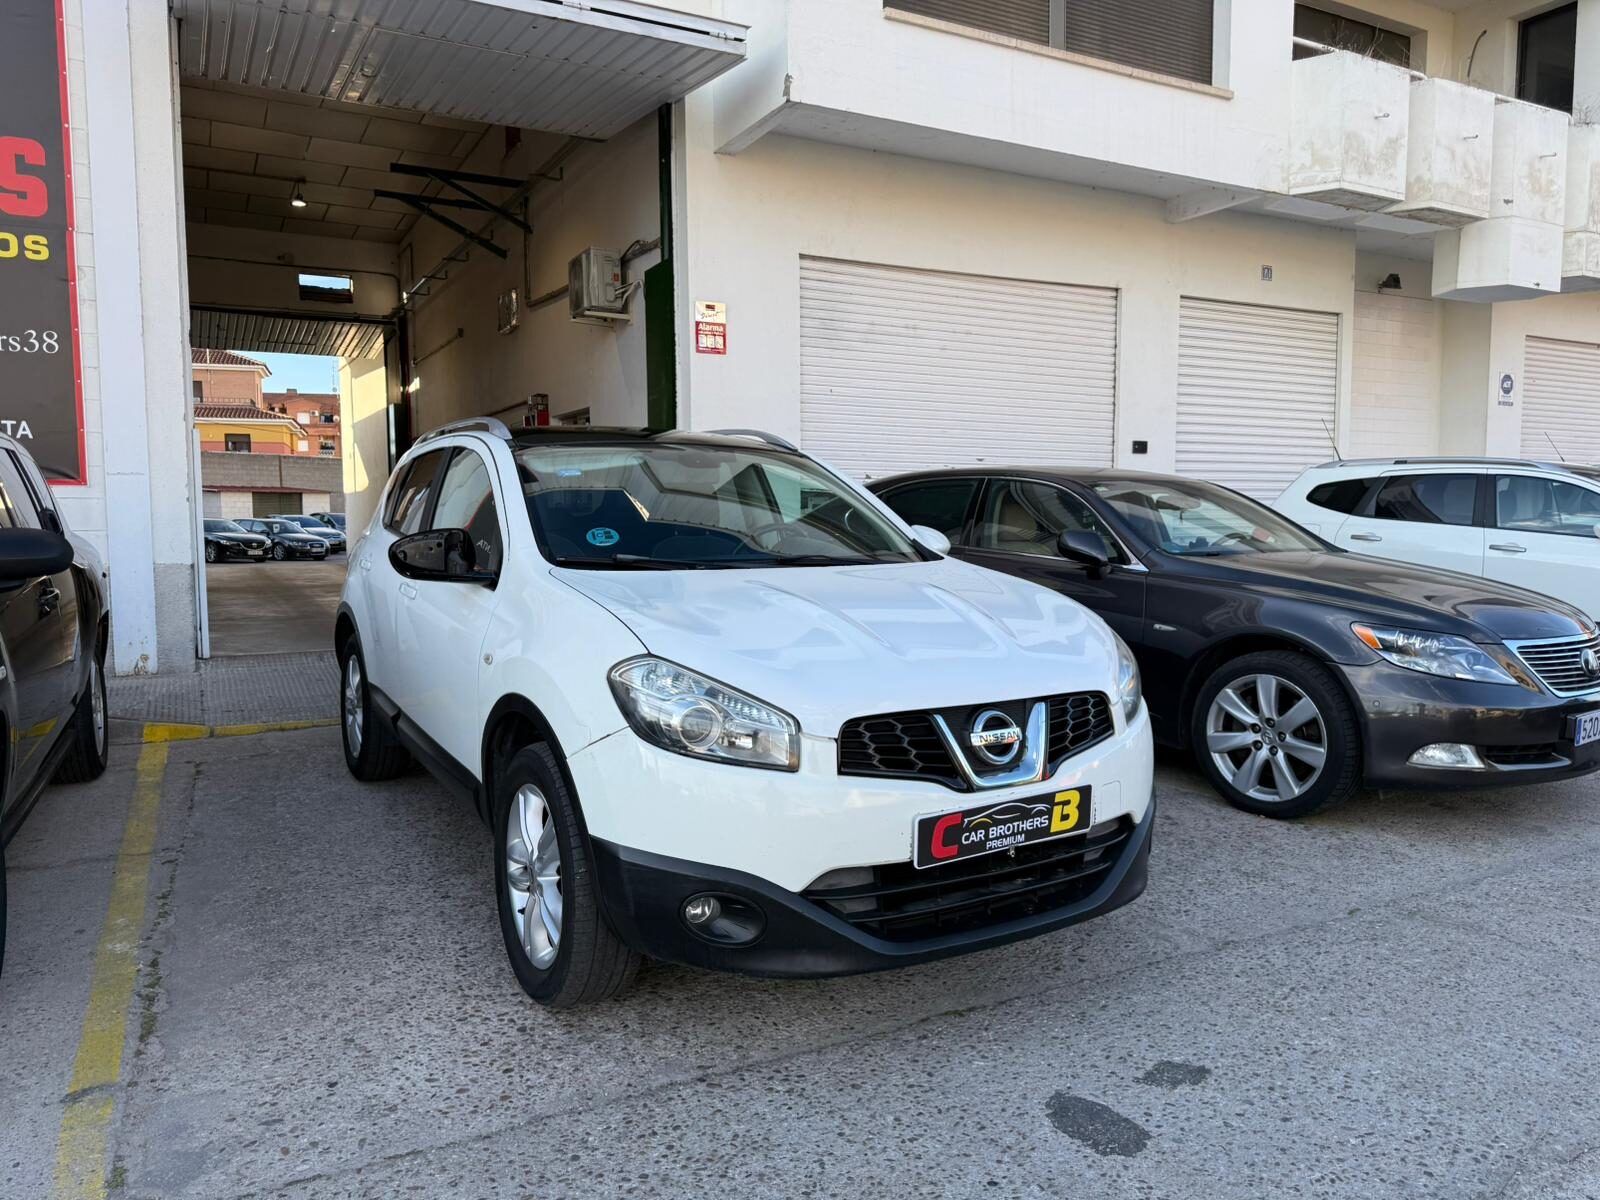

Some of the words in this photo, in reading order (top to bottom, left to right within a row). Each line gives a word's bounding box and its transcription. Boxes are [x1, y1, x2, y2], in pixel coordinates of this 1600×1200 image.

[698, 322, 724, 332] Alarma
[979, 730, 1020, 743] NISSAN
[961, 831, 985, 845] CAR
[988, 815, 1049, 839] BROTHERS
[986, 834, 1025, 850] PREMIUM
